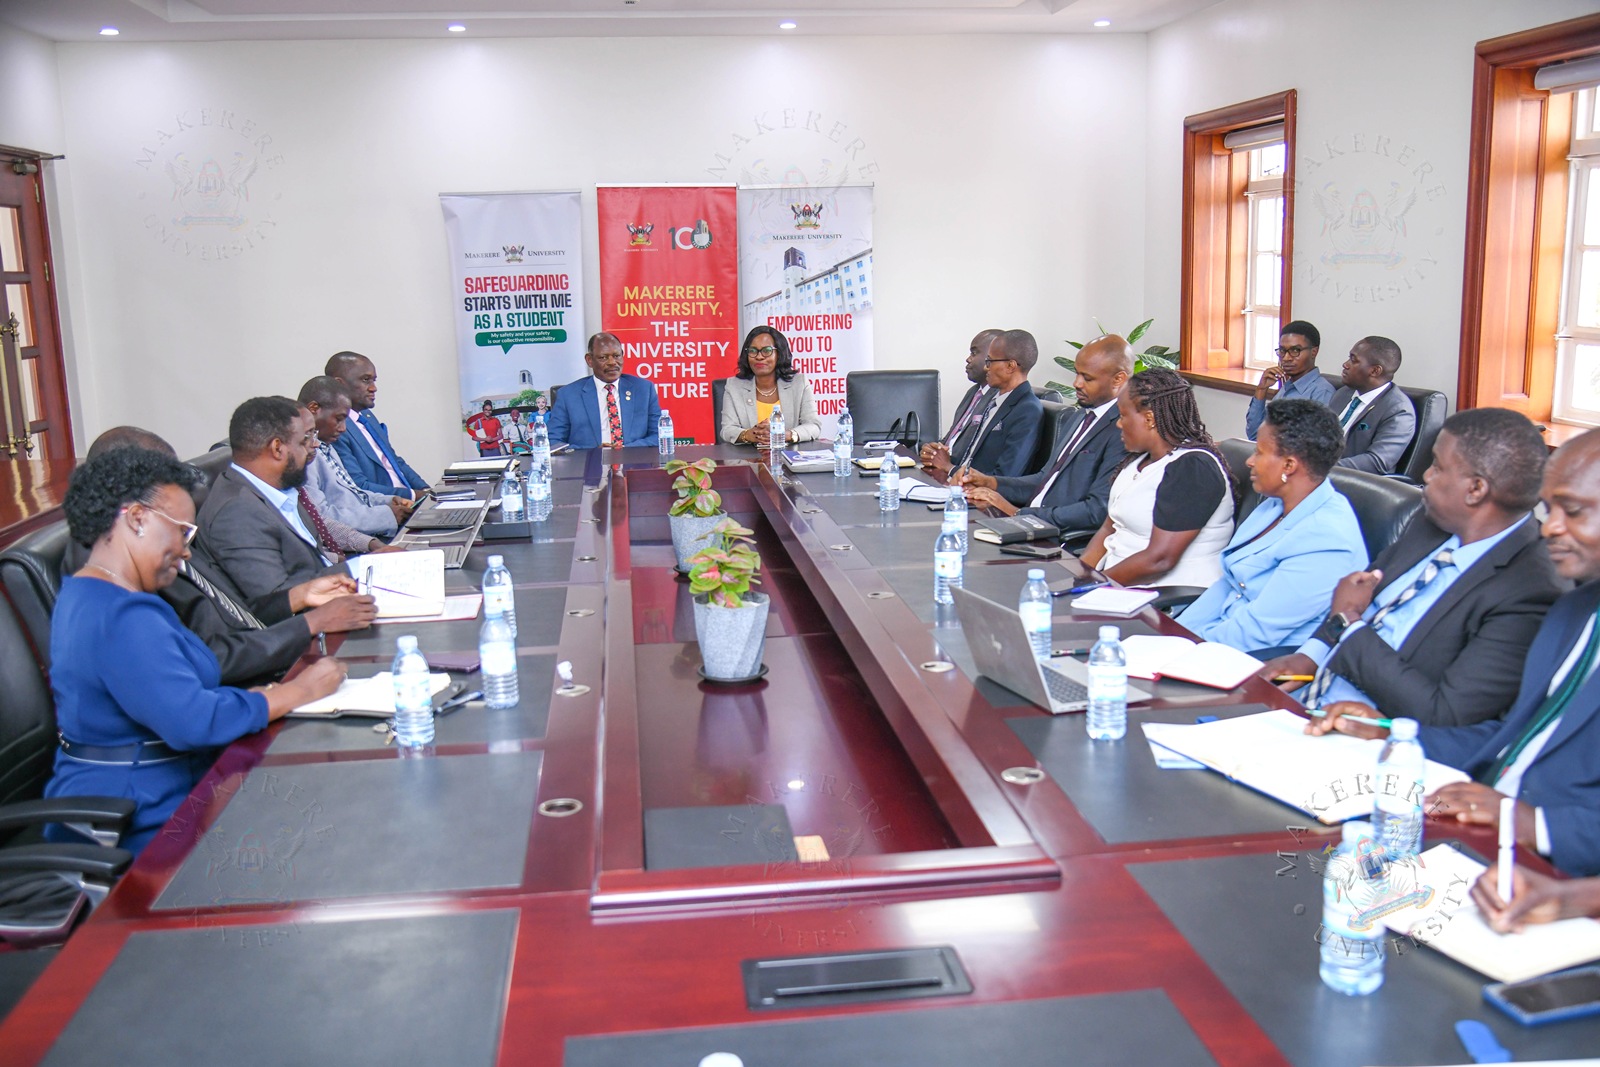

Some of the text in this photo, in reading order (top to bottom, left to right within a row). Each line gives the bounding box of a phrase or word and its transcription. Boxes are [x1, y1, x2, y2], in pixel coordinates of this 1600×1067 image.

[464, 274, 569, 294] SAFEGUARDING
[623, 285, 715, 300] MAKERERE
[464, 293, 572, 312] STARTS WITH ME
[617, 301, 723, 318] UNIVERSITY,
[474, 311, 565, 330] AS A STUDENT
[650, 321, 690, 337] THE
[767, 313, 852, 332] EMPOWERING
[788, 335, 832, 353] YOU TO
[636, 362, 707, 379] OF THE
[792, 357, 837, 374] CHIEVE
[655, 382, 710, 399] TURE
